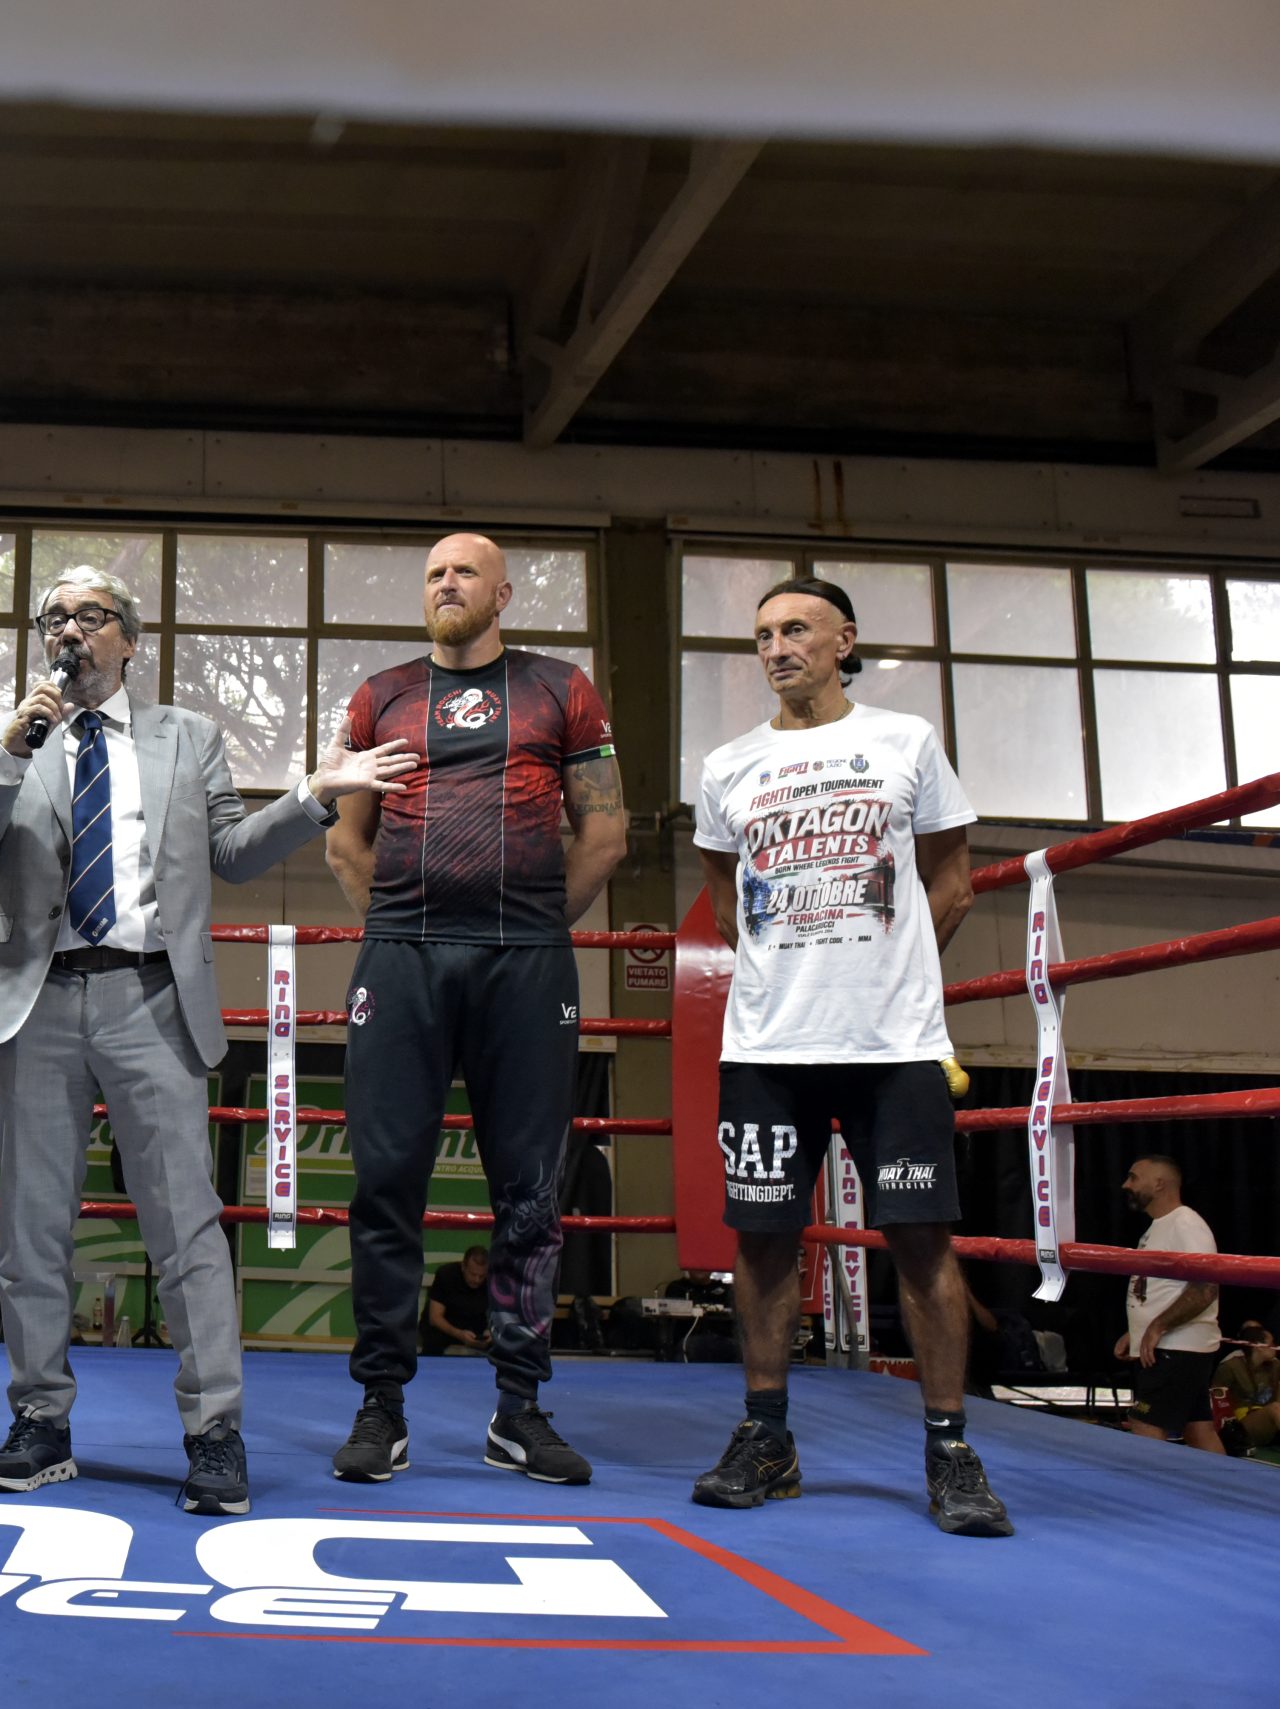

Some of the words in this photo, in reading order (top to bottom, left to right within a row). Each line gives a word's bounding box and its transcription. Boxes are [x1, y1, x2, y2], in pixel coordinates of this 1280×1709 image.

[792, 784, 817, 799] OPEN
[820, 778, 885, 793] TOURNAMENT
[748, 801, 893, 854] OKTAGON
[766, 834, 869, 867] TALENTS
[775, 865, 792, 875] BORN
[793, 862, 814, 871] WHERE
[841, 856, 860, 864] FIGHT
[766, 886, 790, 916] 24
[792, 879, 869, 912] OTTOBRE
[786, 909, 844, 926] TERRACINA
[628, 967, 666, 976] VIETATO
[628, 977, 667, 986] FUMARE
[274, 1075, 292, 1197] SERVICE
[1032, 1056, 1054, 1227] SERVICE
[718, 1121, 798, 1179] SAP
[907, 1166, 935, 1180] THAI
